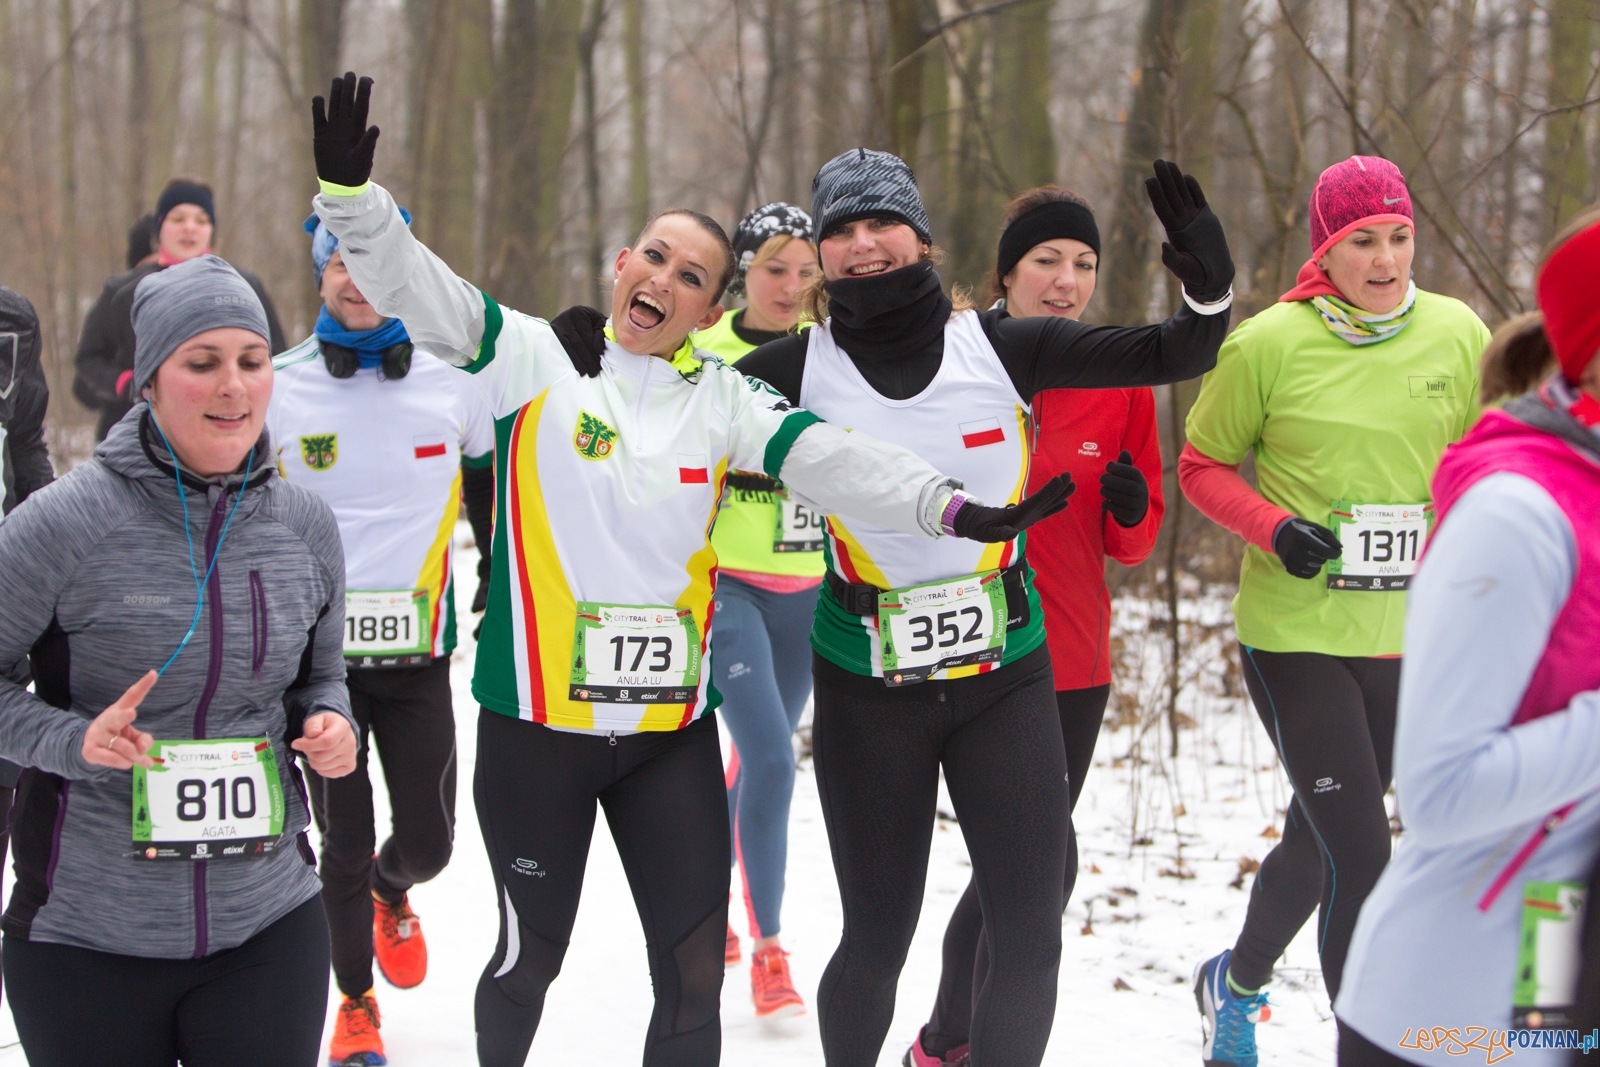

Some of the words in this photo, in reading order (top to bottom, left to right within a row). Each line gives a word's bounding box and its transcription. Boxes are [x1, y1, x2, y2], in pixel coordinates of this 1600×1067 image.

[1358, 529, 1419, 562] 1311
[1378, 566, 1400, 574] ANNA
[345, 614, 410, 642] 1881
[908, 605, 983, 652] 352
[609, 635, 672, 672] 173
[690, 644, 698, 676] Poznań
[616, 676, 648, 685] ANULA
[650, 677, 662, 685] LU
[176, 776, 256, 822] 810
[201, 826, 237, 838] AGATA
[511, 863, 546, 878] Kalenji
